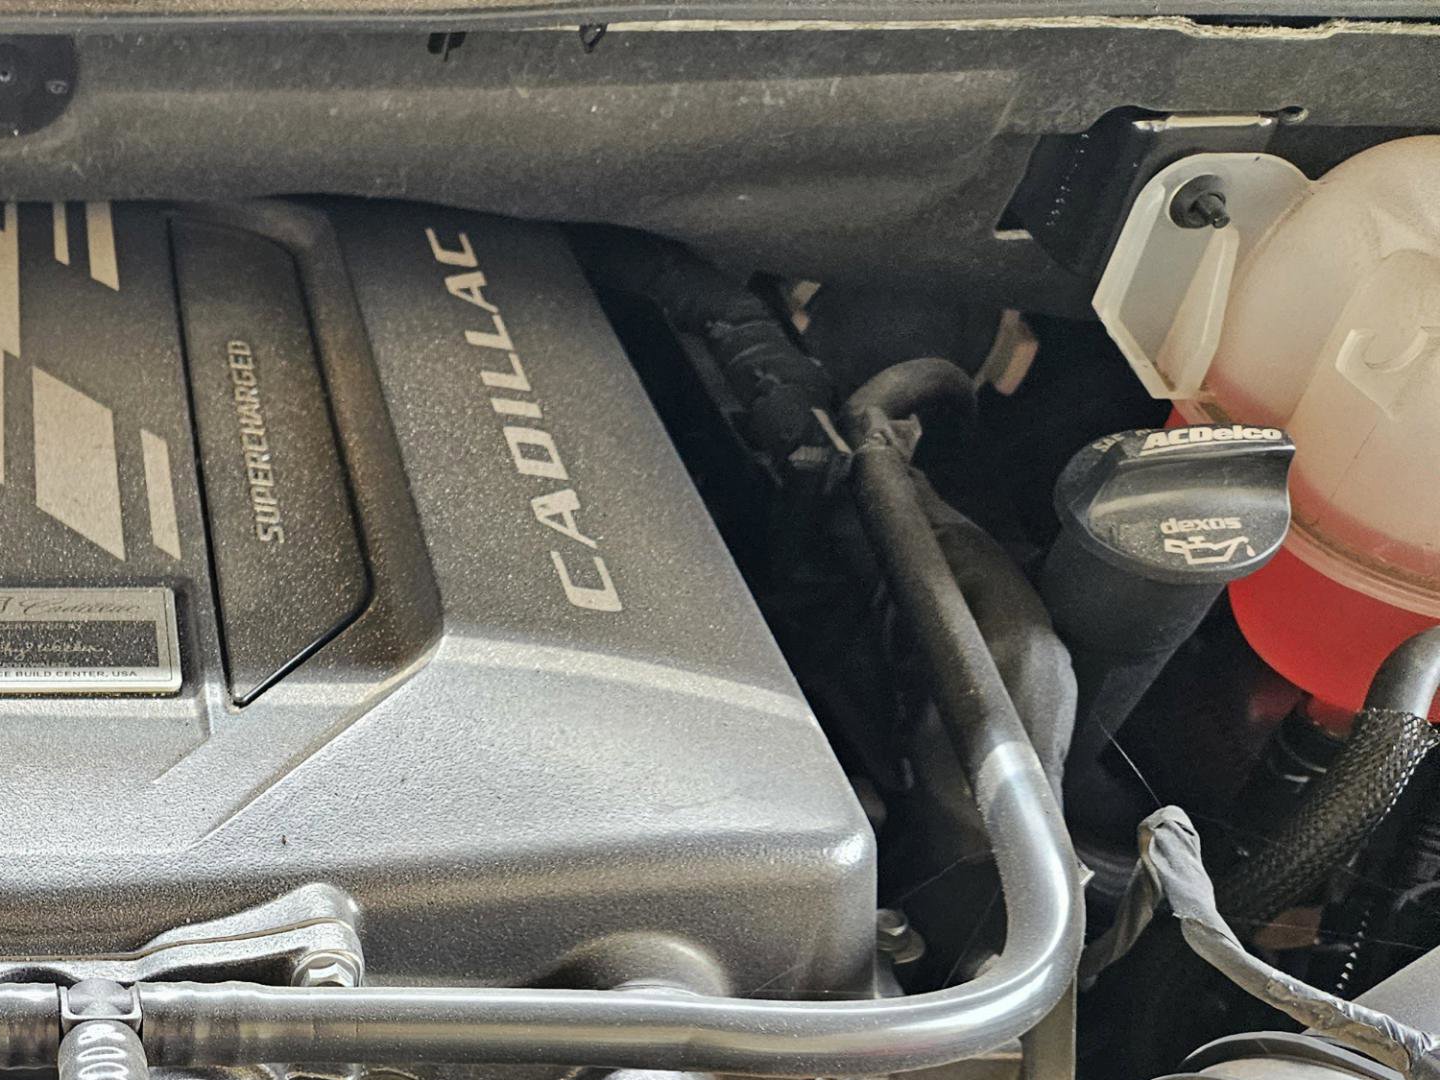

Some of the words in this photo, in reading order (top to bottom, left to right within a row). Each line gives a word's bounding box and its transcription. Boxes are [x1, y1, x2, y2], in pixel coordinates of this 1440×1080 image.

[425, 227, 623, 613] CADILLAC
[227, 339, 285, 543] SUPERCHARGED
[1142, 425, 1282, 450] ACDelco
[1160, 516, 1242, 535] dexos
[56, 671, 109, 679] CENTER,
